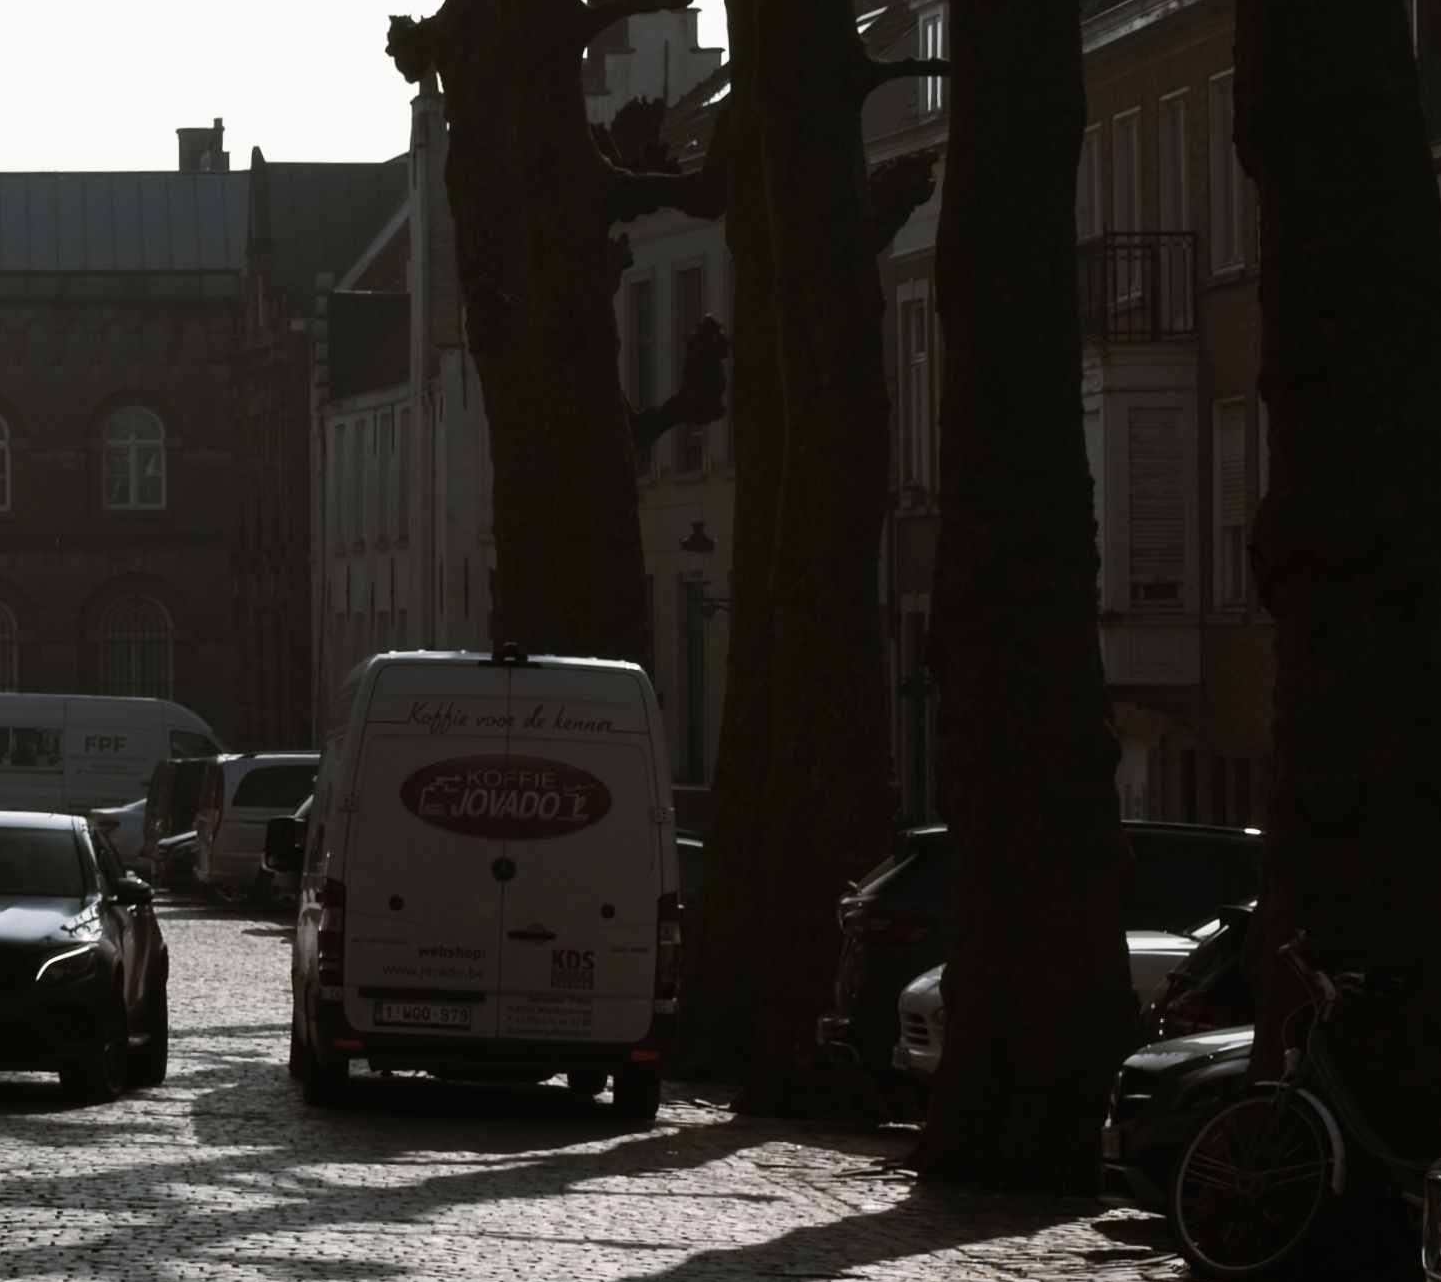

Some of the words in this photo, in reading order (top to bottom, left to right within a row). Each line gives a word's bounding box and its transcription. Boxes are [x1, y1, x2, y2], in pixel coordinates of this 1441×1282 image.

[407, 702, 469, 734] Koffie
[476, 716, 514, 728] voor
[524, 705, 544, 729] de
[553, 706, 615, 732] kenner
[84, 736, 127, 752] FPF
[467, 769, 557, 789] KOFFIE
[450, 788, 561, 819] JOVADO
[418, 946, 486, 960] webshop:
[552, 949, 595, 969] KDS
[383, 966, 486, 980] www.jovado.be
